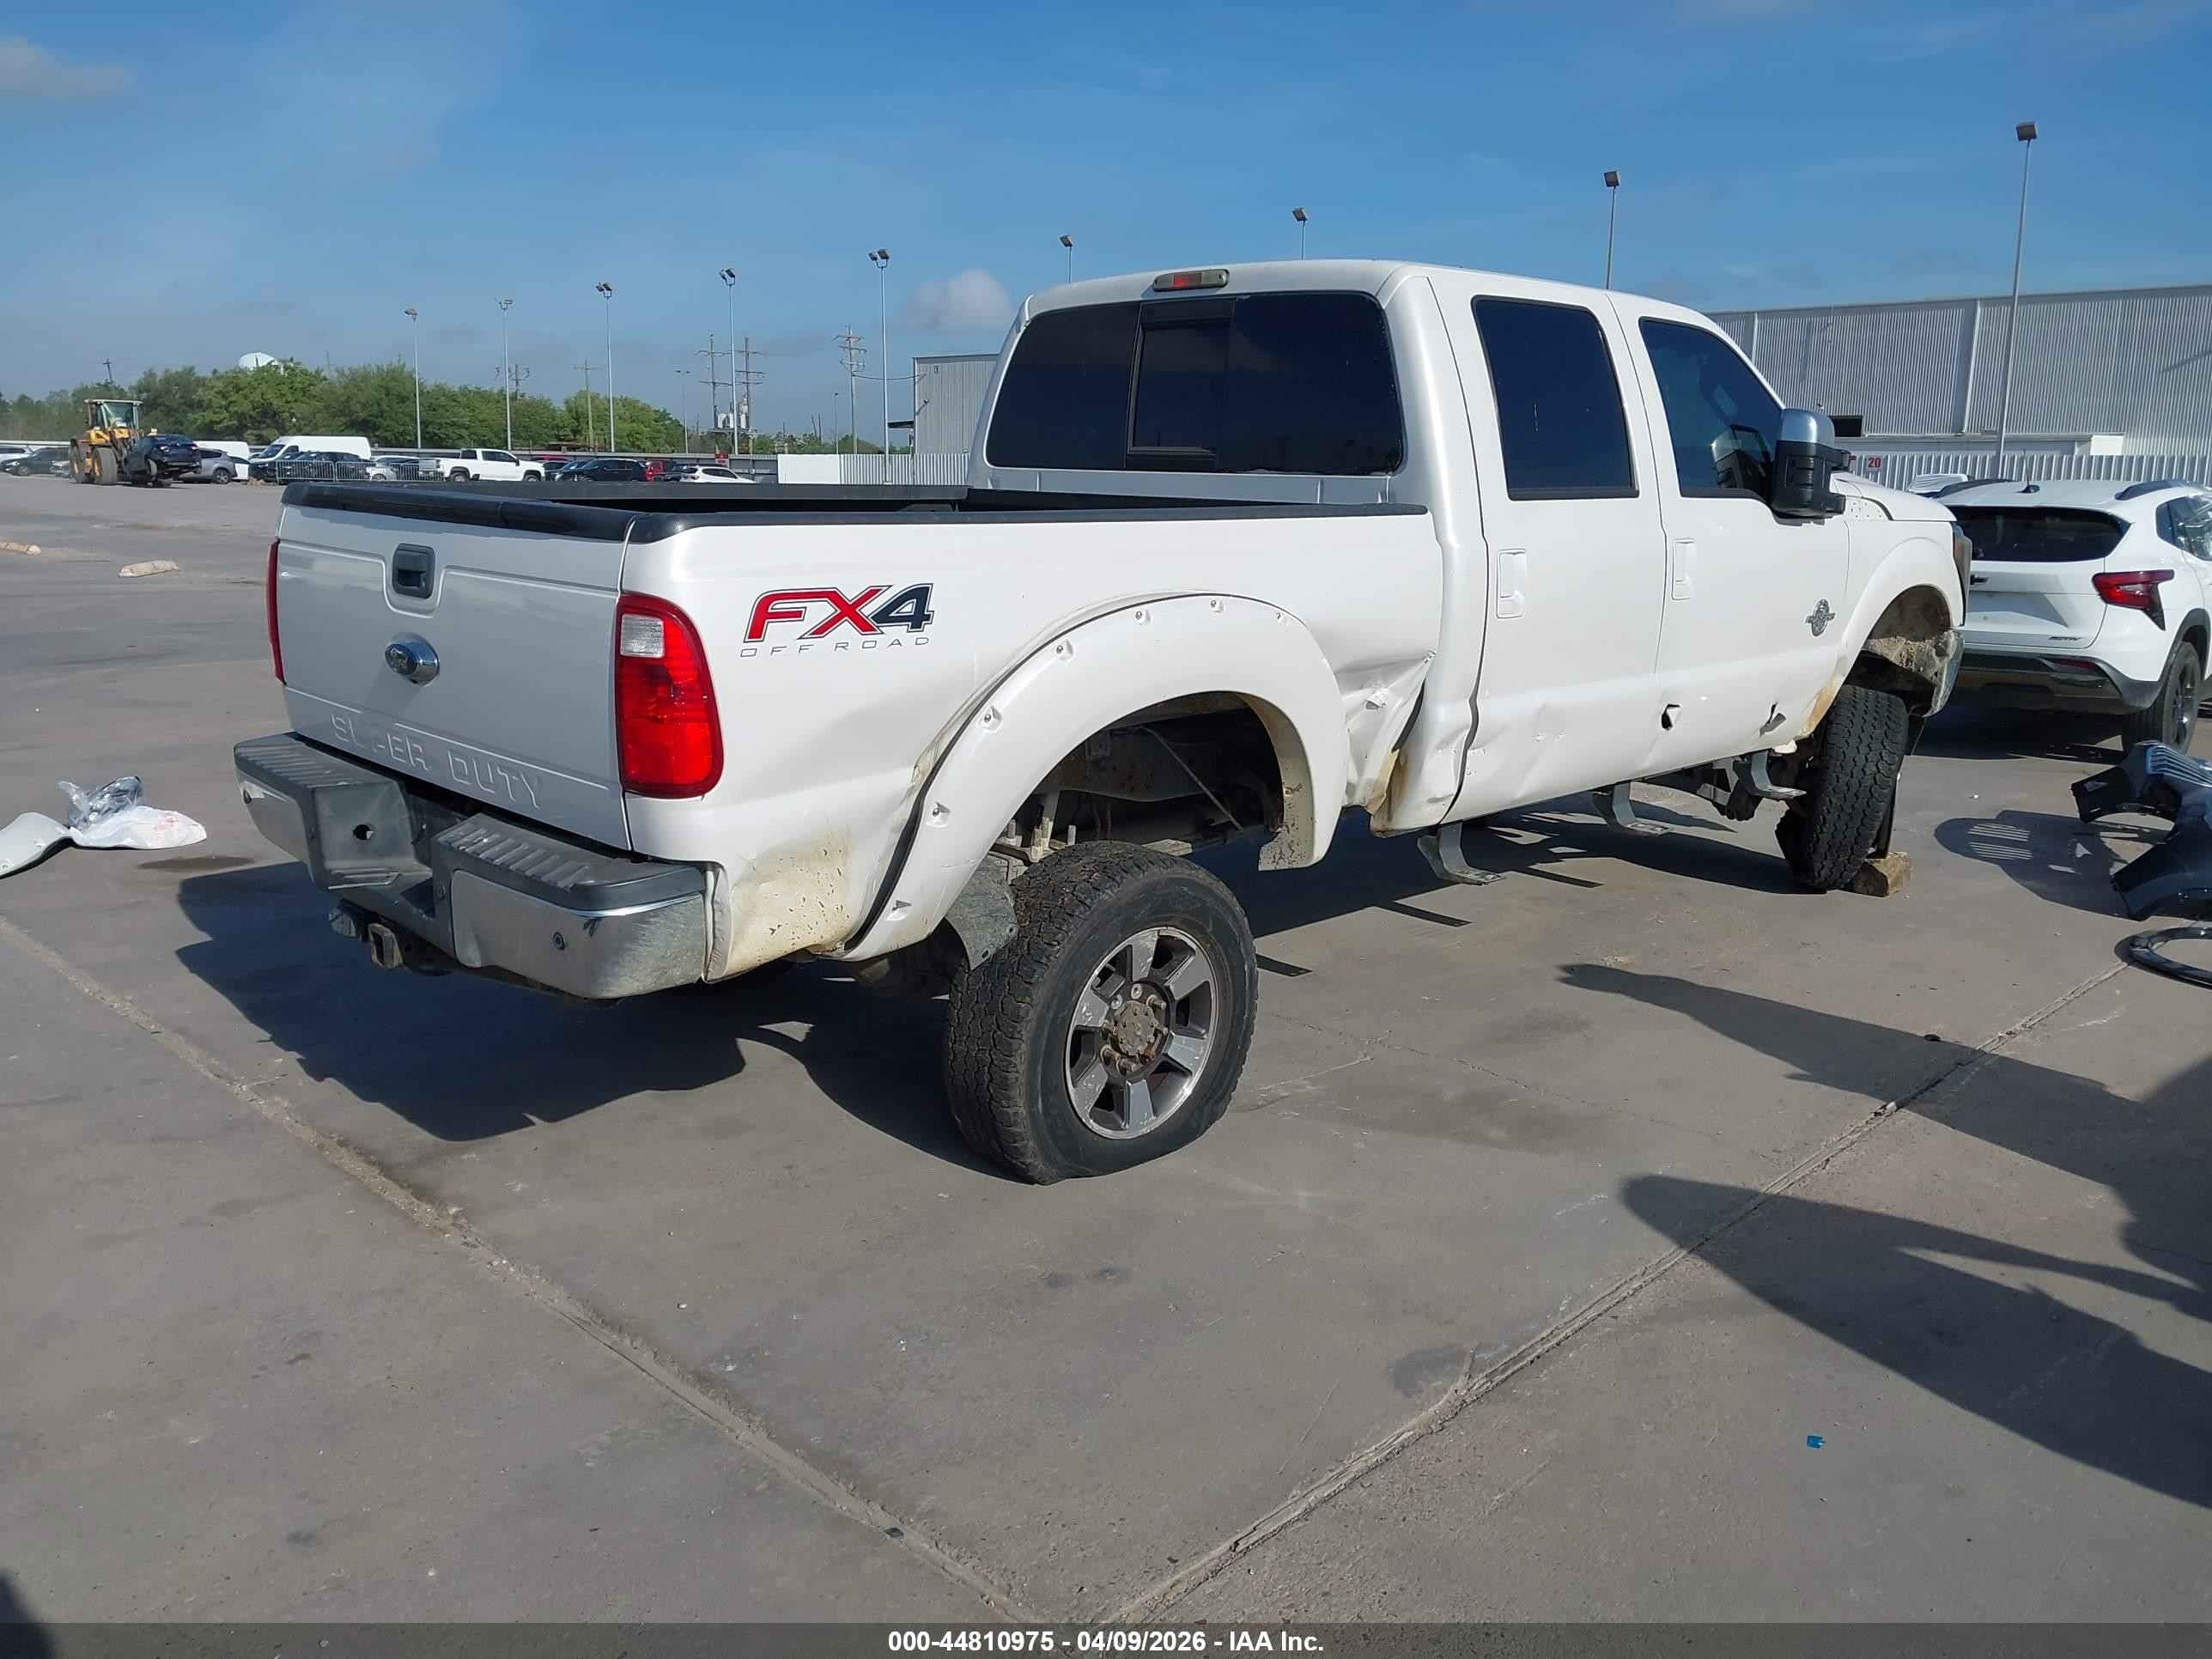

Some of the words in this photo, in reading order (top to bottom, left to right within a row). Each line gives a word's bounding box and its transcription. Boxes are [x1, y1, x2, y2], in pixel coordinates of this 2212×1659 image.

[1868, 457, 1881, 468] 20
[743, 583, 934, 642] FX4
[739, 644, 814, 657] OFF
[834, 636, 930, 652] ROAD
[446, 747, 543, 809] DUTY
